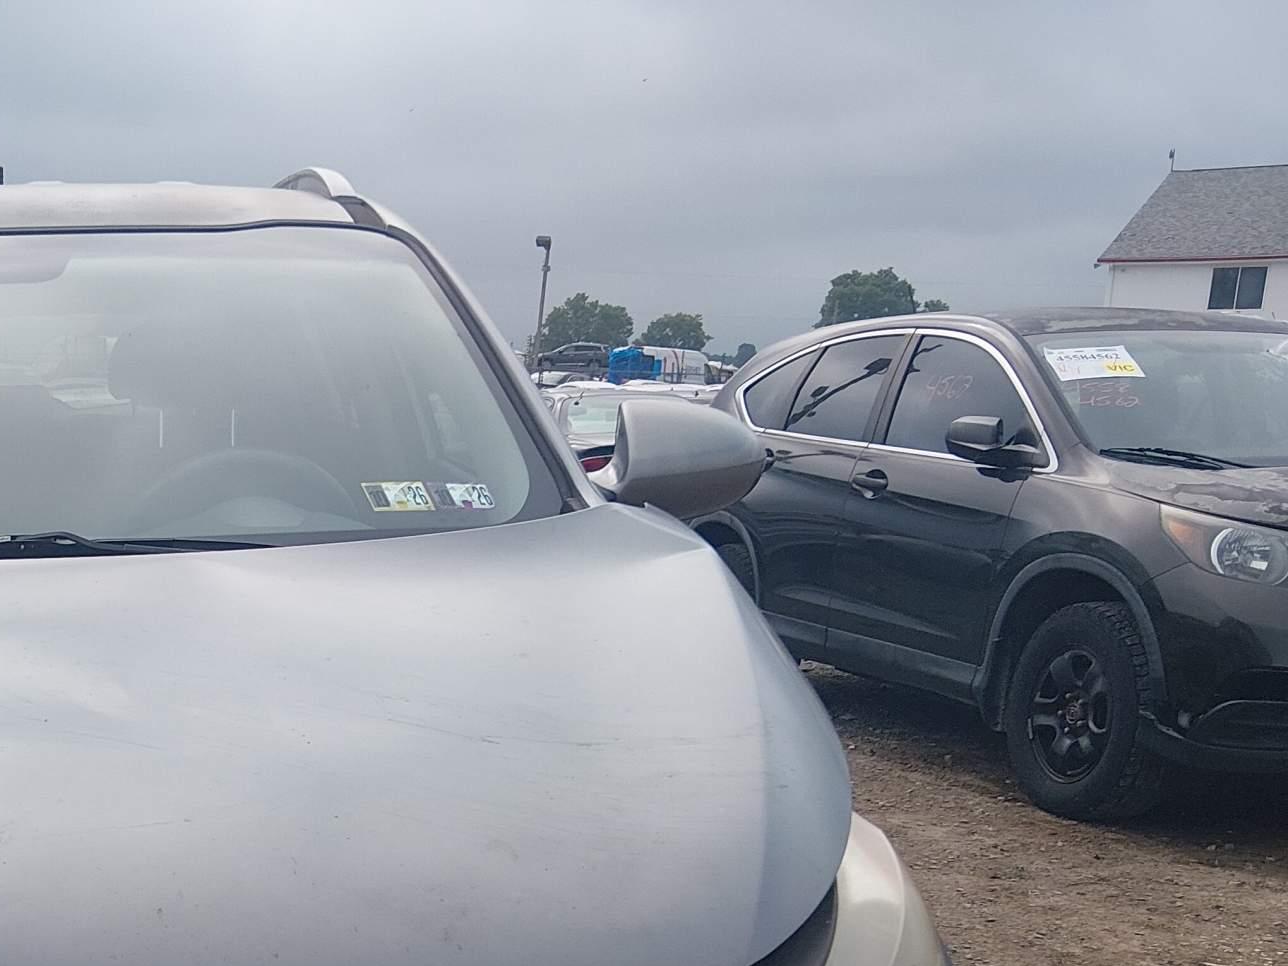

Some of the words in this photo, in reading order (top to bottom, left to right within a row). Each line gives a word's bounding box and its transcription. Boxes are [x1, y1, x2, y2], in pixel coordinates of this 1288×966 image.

[1106, 364, 1135, 372] VIC
[407, 485, 429, 506] 26
[472, 485, 494, 506] 26
